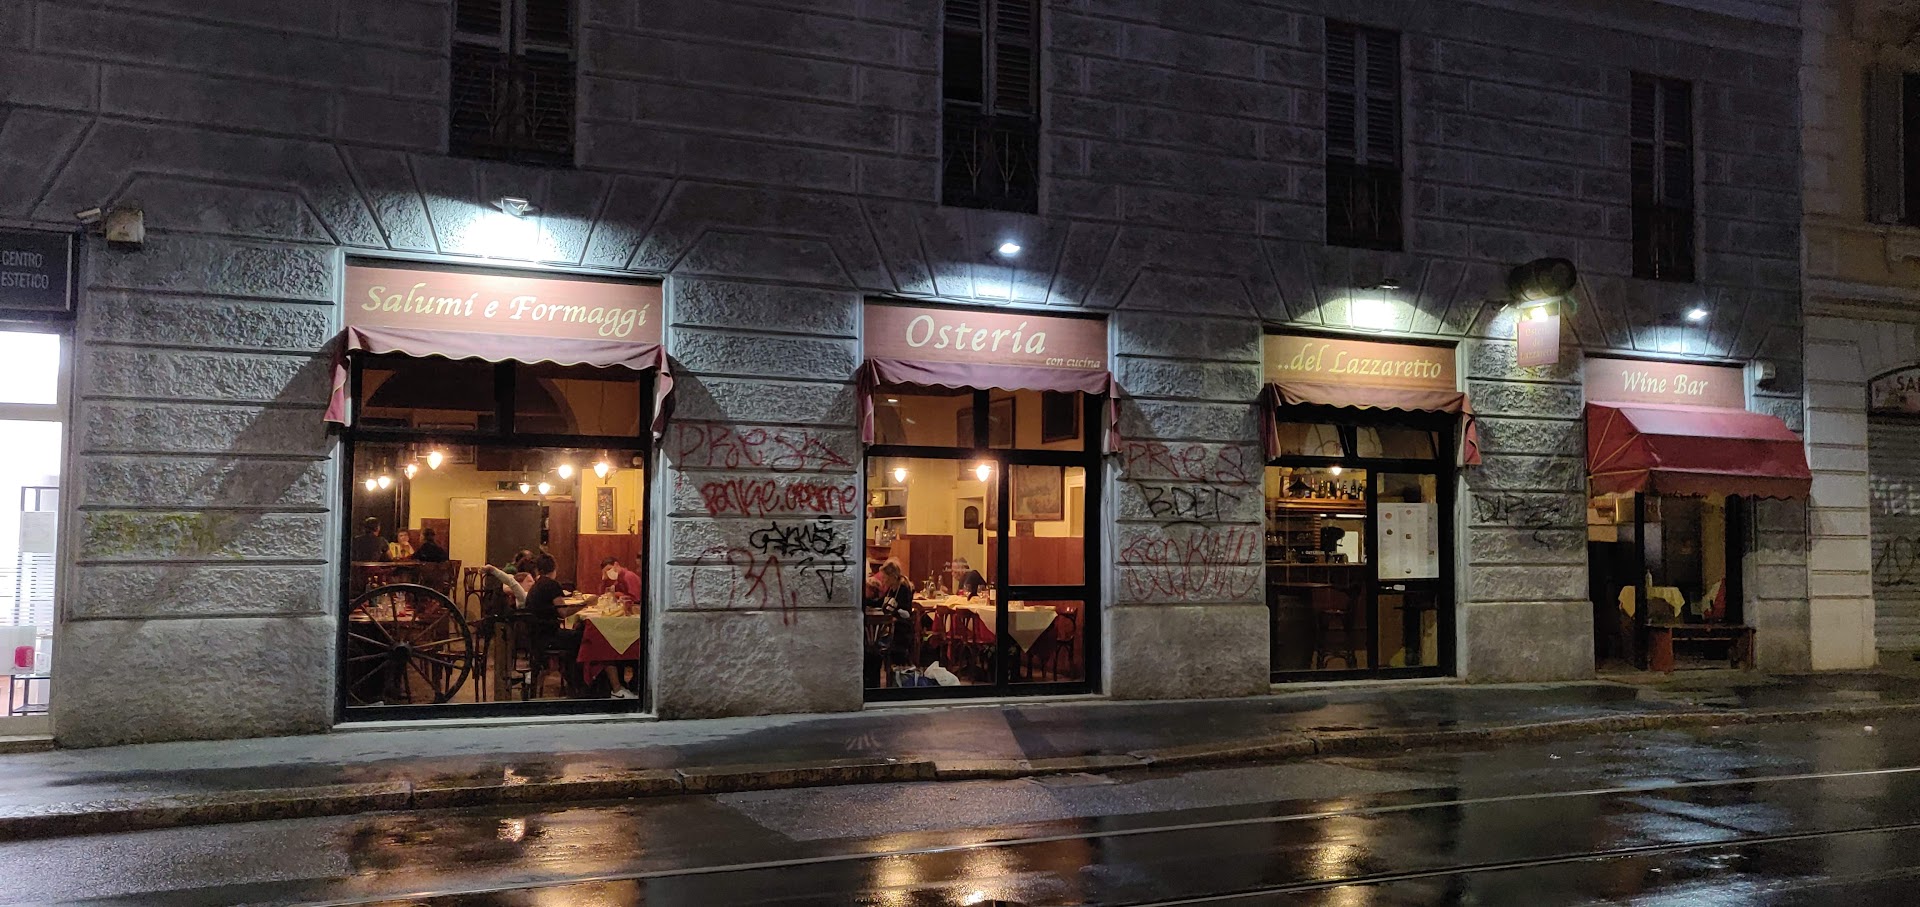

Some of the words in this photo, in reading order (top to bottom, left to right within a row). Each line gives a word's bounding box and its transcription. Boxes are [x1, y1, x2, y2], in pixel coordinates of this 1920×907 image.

[2, 250, 43, 268] CENTRO
[1, 271, 49, 289] ESTETICO
[361, 282, 479, 317] Salumi
[484, 299, 500, 319] e
[509, 295, 650, 338] Formaggi
[905, 314, 1047, 354] Osteria
[1046, 356, 1064, 367] con
[1066, 357, 1101, 369] cucina
[1328, 350, 1442, 379] Lazzaretto
[1621, 370, 1667, 395] Wine
[1673, 374, 1709, 396] Bar
[1896, 375, 1920, 393] SA
